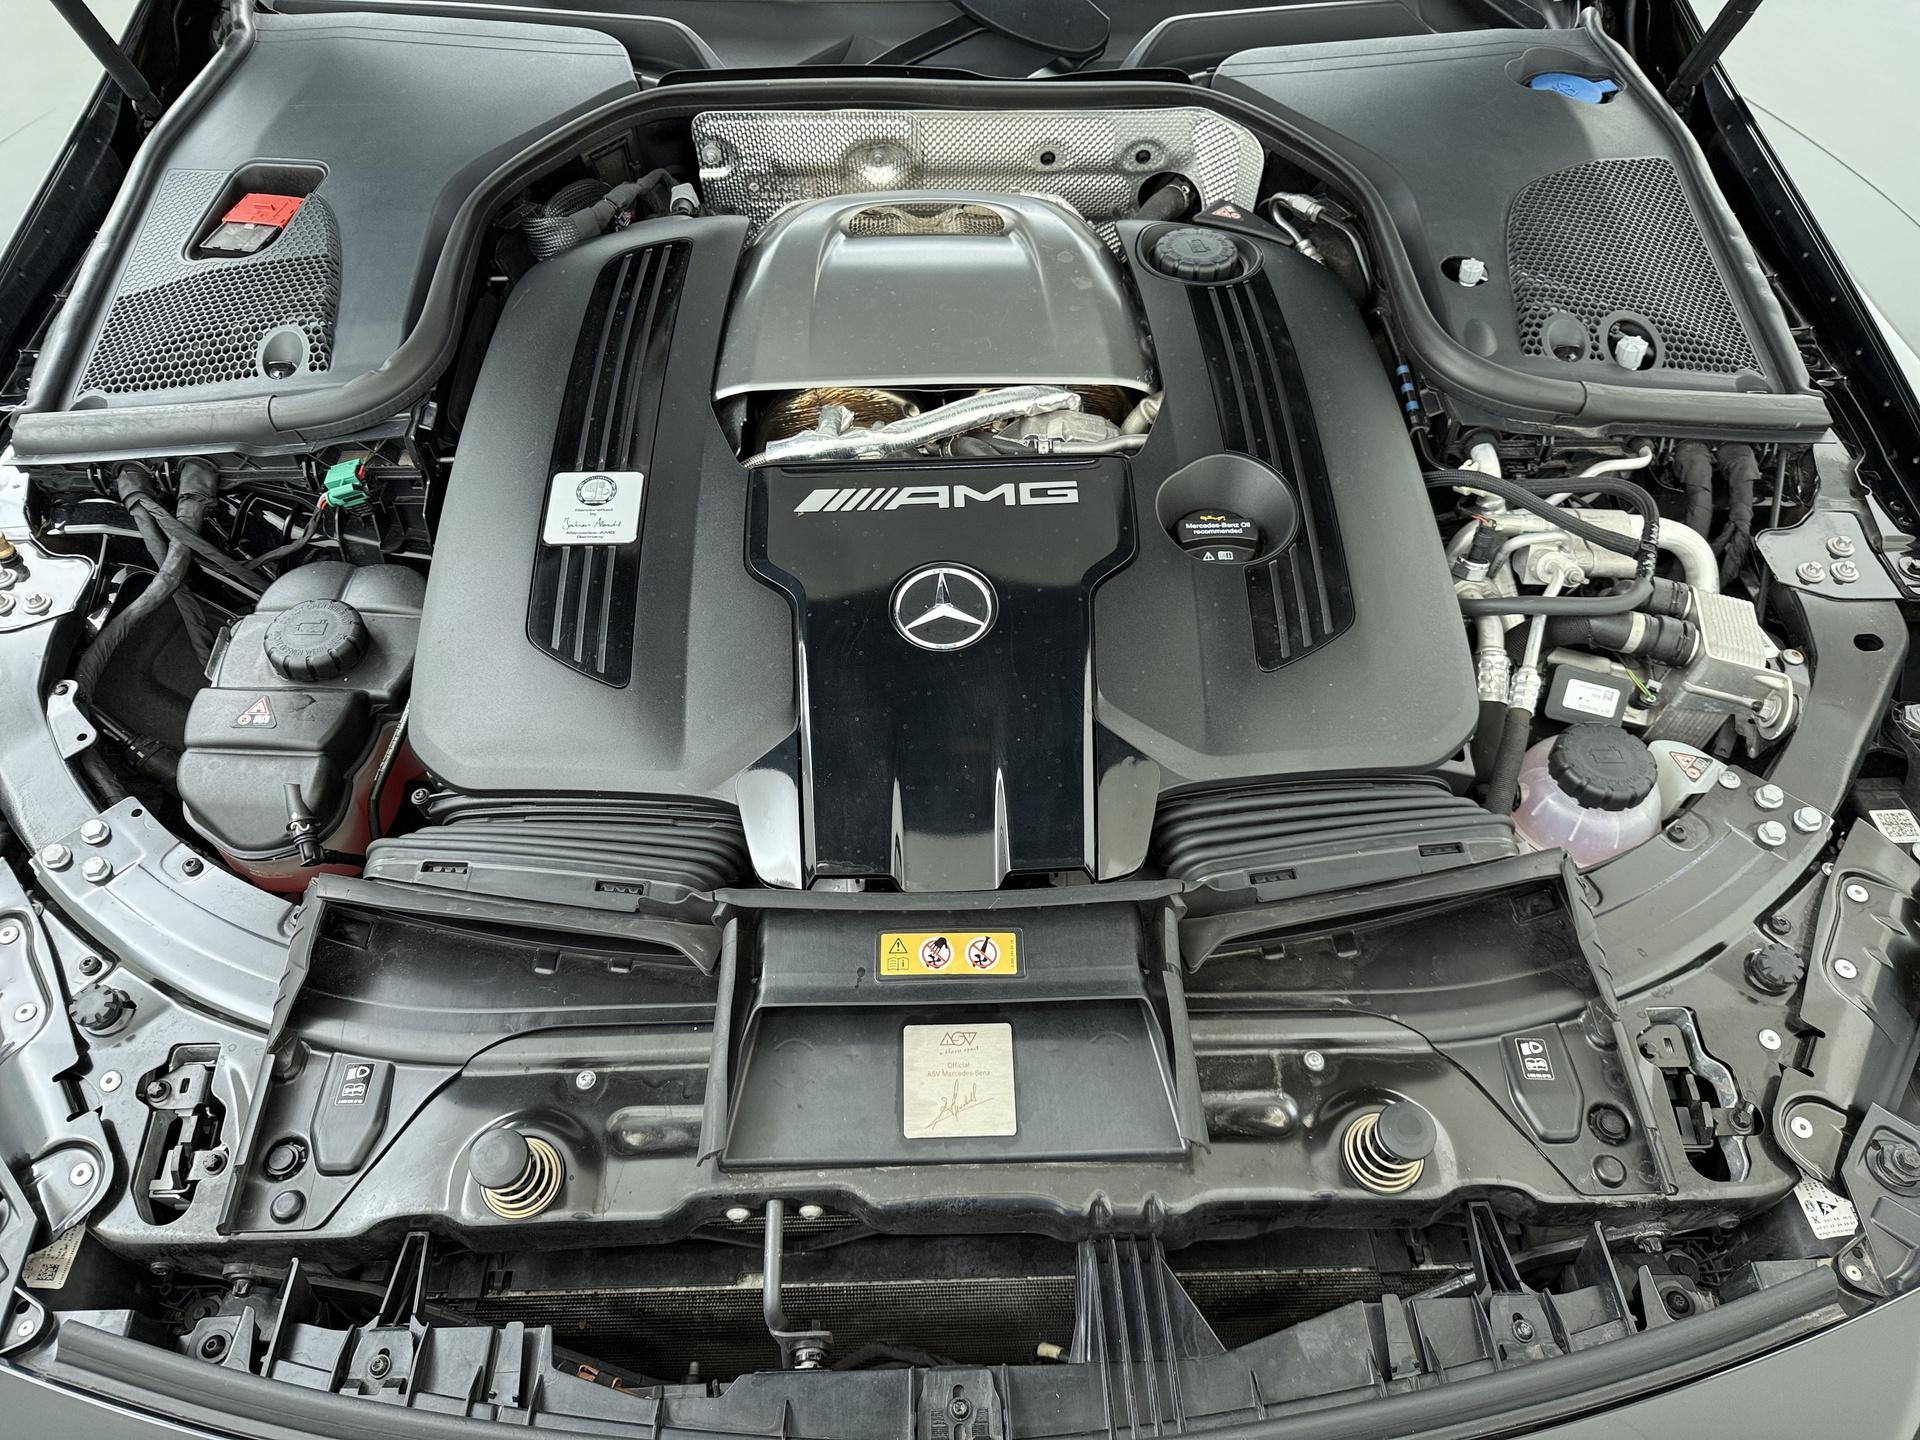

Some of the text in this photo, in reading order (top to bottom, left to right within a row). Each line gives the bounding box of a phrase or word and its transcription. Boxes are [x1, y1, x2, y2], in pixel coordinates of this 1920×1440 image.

[884, 480, 1079, 509] AMG
[940, 1031, 978, 1046] ASV
[947, 1061, 970, 1069] Official
